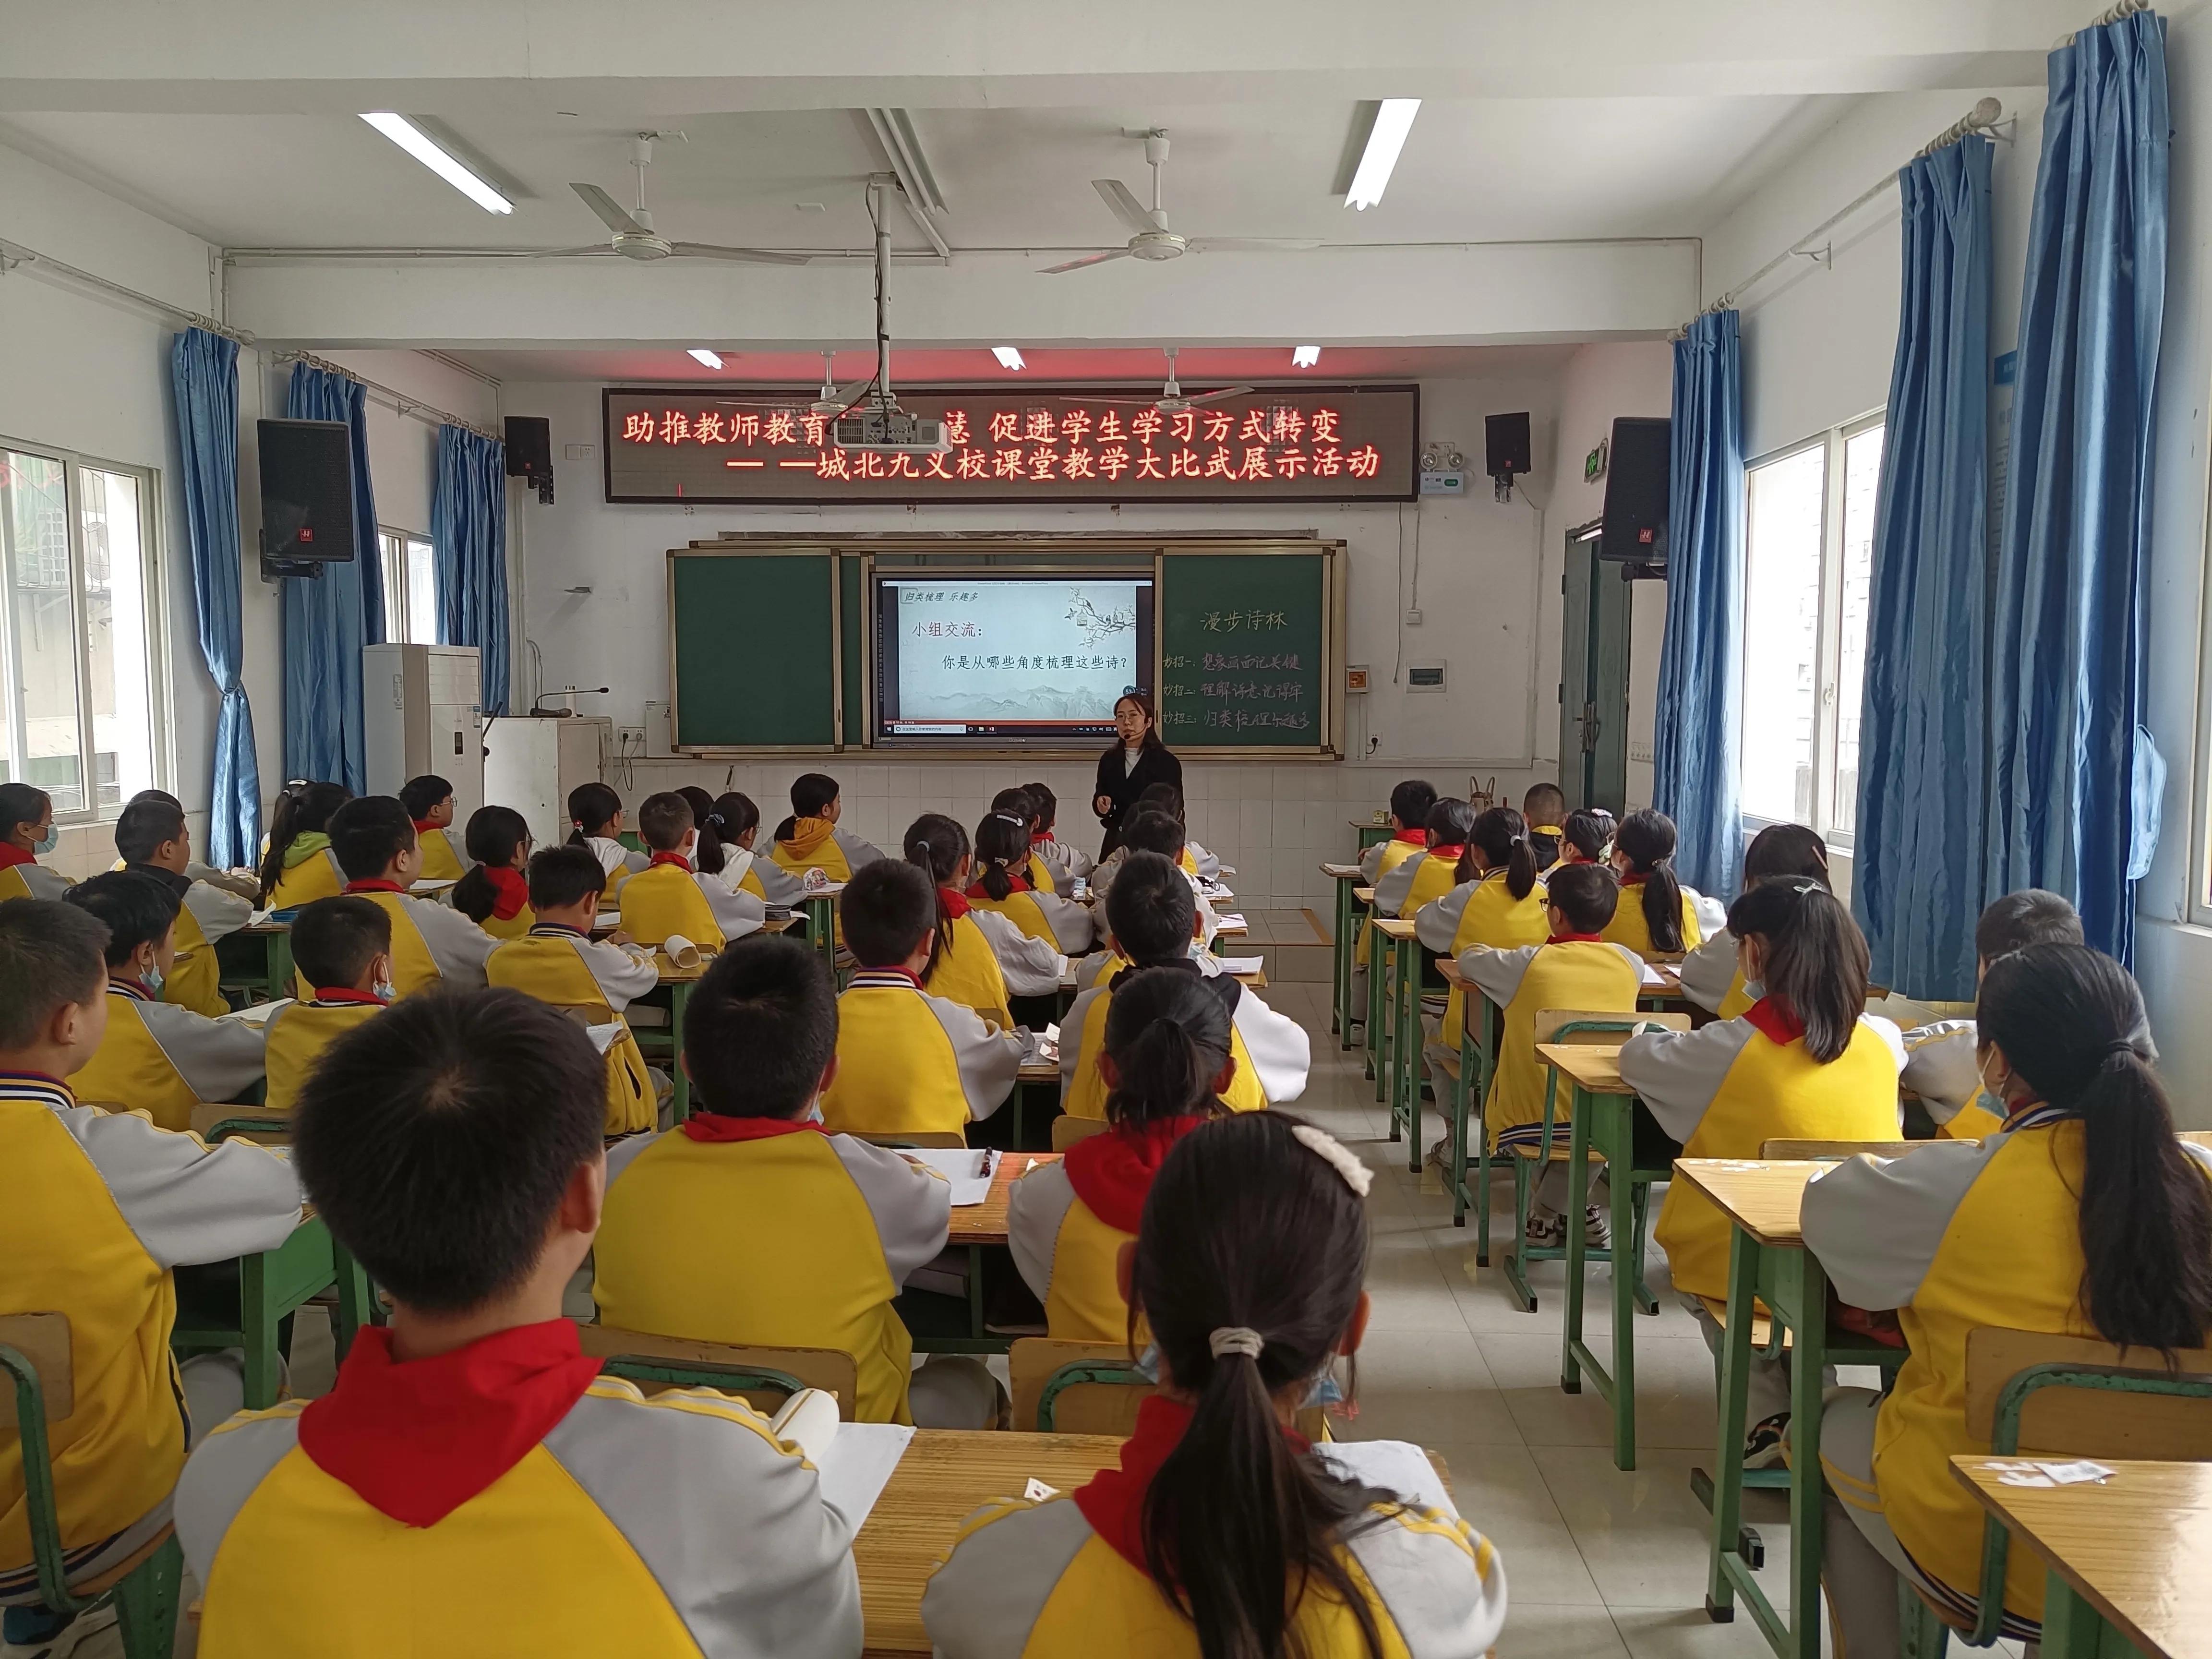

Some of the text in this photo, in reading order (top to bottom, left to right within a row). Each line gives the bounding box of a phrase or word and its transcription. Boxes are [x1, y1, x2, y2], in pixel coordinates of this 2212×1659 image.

[623, 409, 1341, 446] 助推教师教育慧 促进学生学习方式转变
[905, 591, 978, 602] 归类梳理 乐趣多
[912, 621, 983, 637] 小组交流：
[1200, 610, 1288, 632] 漫步诗林
[941, 655, 1127, 670] 你是从哪些角度梳理这些诗？
